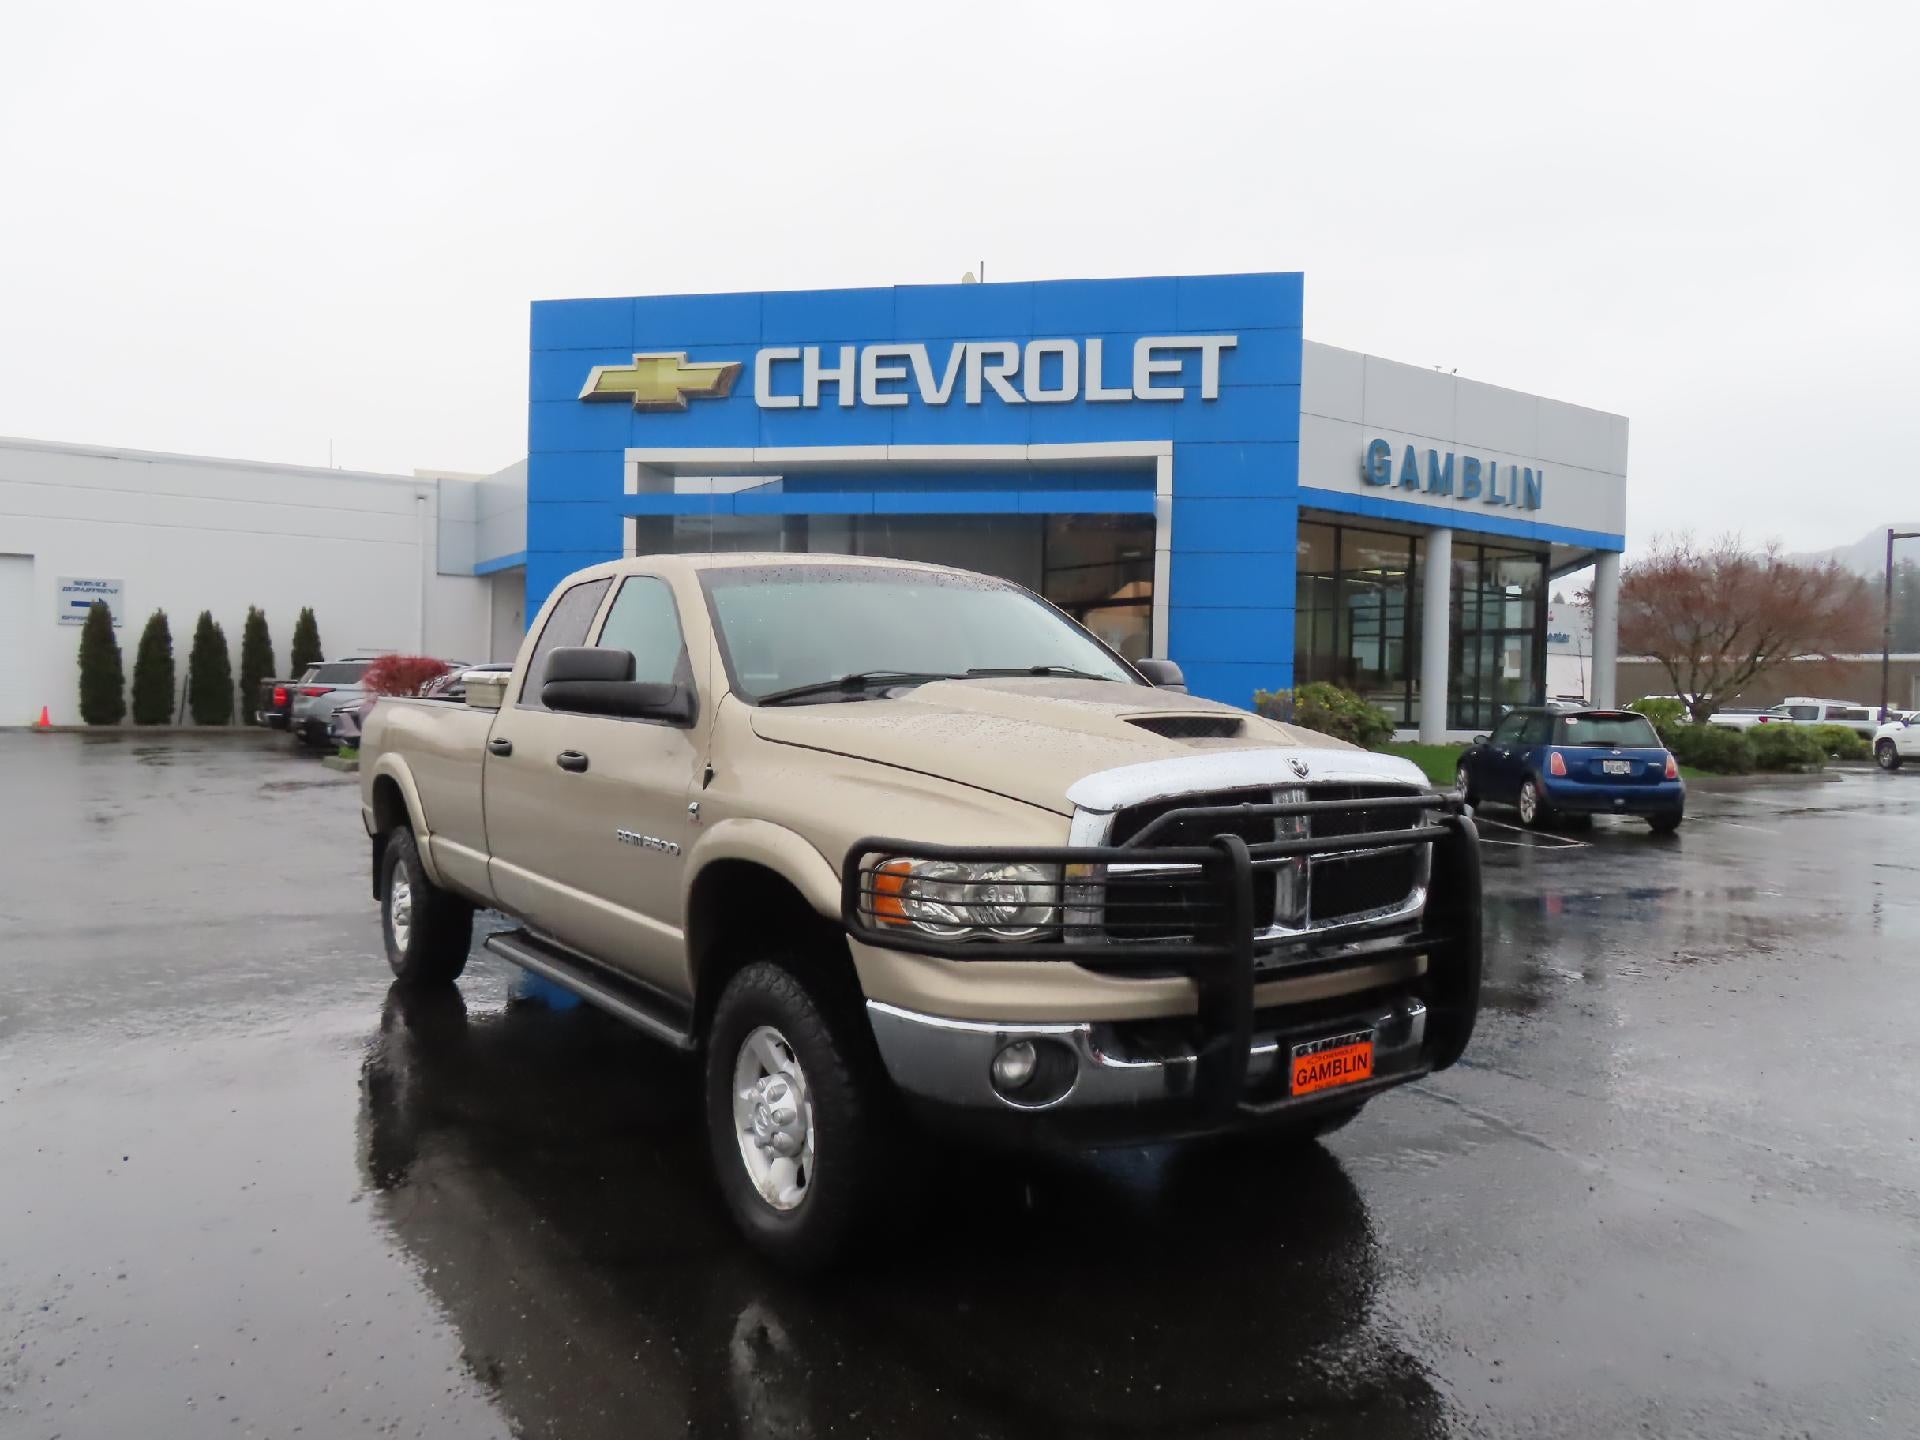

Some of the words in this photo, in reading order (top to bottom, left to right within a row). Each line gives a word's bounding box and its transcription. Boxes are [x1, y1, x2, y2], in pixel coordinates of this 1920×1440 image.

[754, 335, 1238, 408] CHEVROLET
[1361, 438, 1543, 511] GAMBLIN
[1296, 1052, 1368, 1087] GAMBLIN
